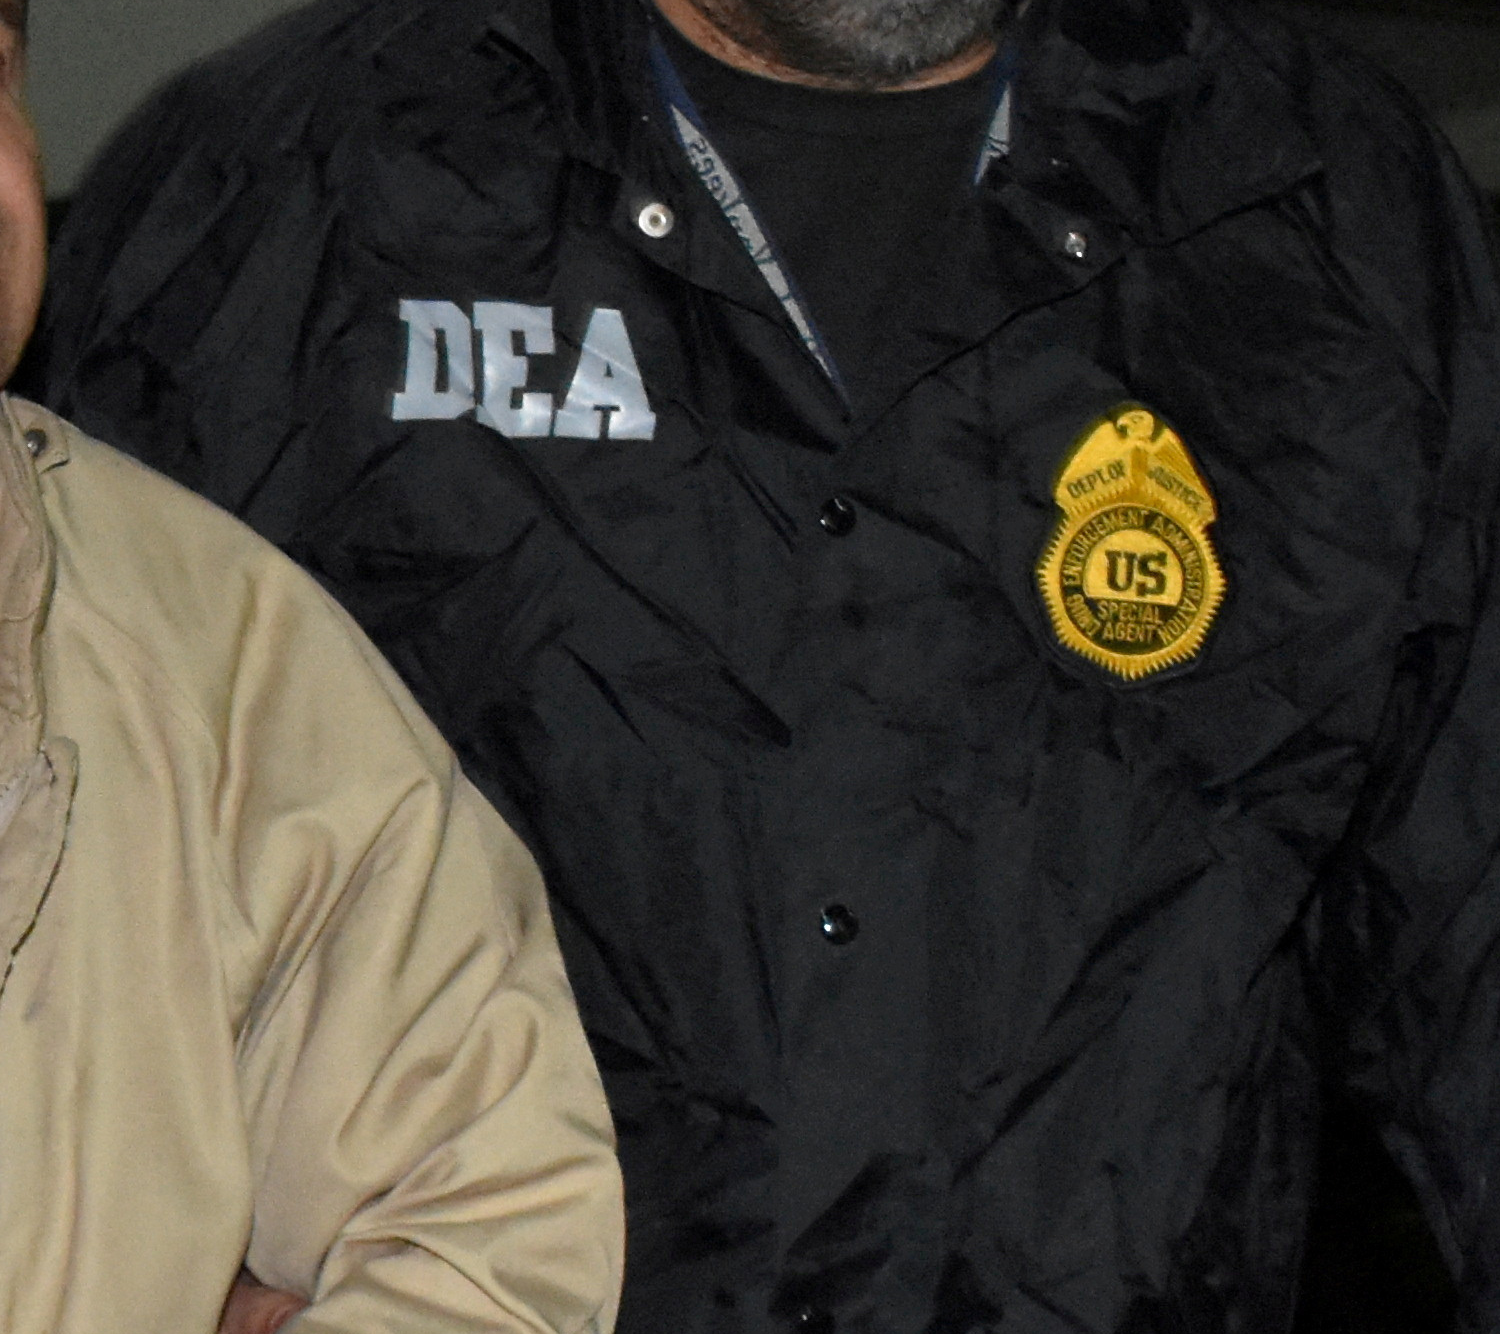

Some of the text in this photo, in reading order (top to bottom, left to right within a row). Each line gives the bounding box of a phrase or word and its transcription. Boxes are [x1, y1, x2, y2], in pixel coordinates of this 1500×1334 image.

[392, 299, 656, 440] DEA
[1062, 509, 1150, 586] ENFORCEMENT
[1151, 515, 1202, 646] ADMINISTRATION
[1104, 550, 1168, 597] US
[1097, 598, 1164, 628] SPECIAL
[1102, 619, 1160, 644] AGENT
